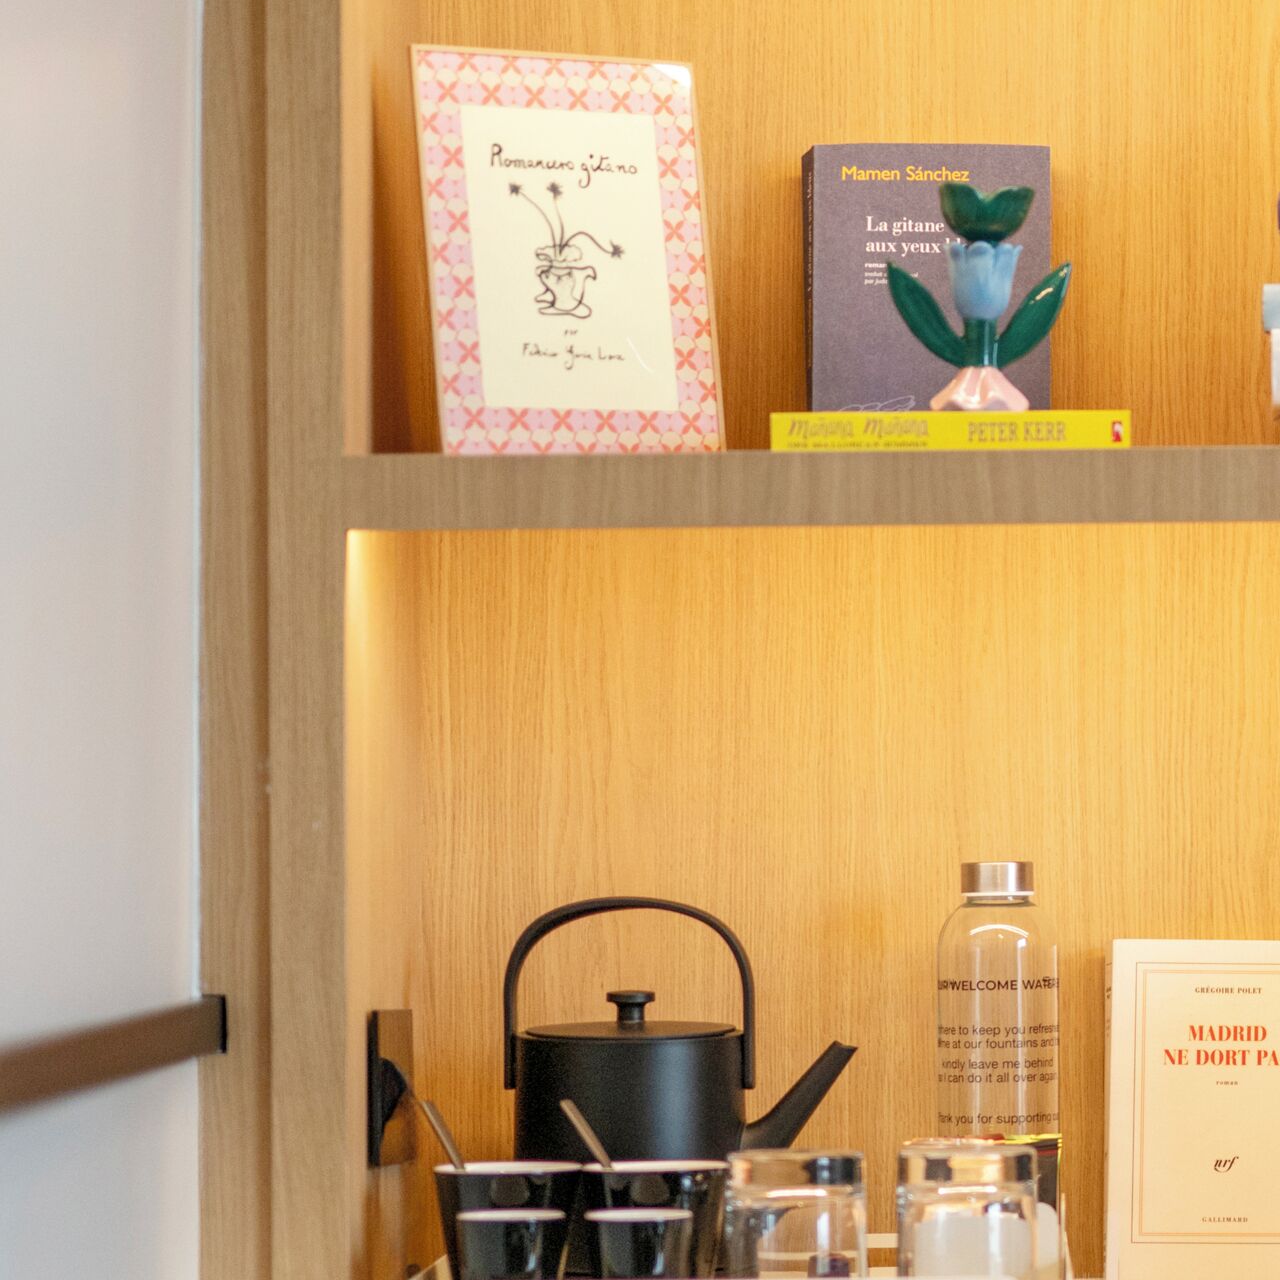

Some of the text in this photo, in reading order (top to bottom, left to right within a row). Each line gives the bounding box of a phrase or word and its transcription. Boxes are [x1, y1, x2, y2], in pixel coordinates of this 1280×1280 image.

[490, 143, 638, 189] Romancero gitano
[842, 166, 970, 181] Mamen Sánchez
[866, 216, 945, 236] La gitane
[865, 242, 897, 253] aux
[901, 242, 941, 257] yeux
[967, 421, 1067, 442] PETER KERR
[950, 979, 1018, 991] WELCOME
[1195, 986, 1262, 995] GRÉGOIRE POLET
[959, 1025, 969, 1035] to
[972, 1025, 1001, 1037] keep
[1004, 1026, 1026, 1037] you
[1188, 1025, 1267, 1041] MADRID
[952, 1039, 961, 1048] at
[964, 1040, 982, 1049] our
[985, 1038, 1038, 1049] fountains
[968, 1059, 998, 1070] leave
[1002, 1060, 1020, 1069] me
[1024, 1057, 1054, 1068] behind
[1163, 1049, 1189, 1065] NE
[1196, 1049, 1250, 1066] DORT
[948, 1074, 964, 1083] can
[967, 1073, 982, 1083] do
[985, 1073, 992, 1082] it
[996, 1073, 1010, 1083] all
[1013, 1073, 1037, 1082] over
[955, 1114, 974, 1126] you
[977, 1113, 993, 1124] for
[996, 1112, 1052, 1126] supporting
[1214, 1156, 1239, 1173] nrf
